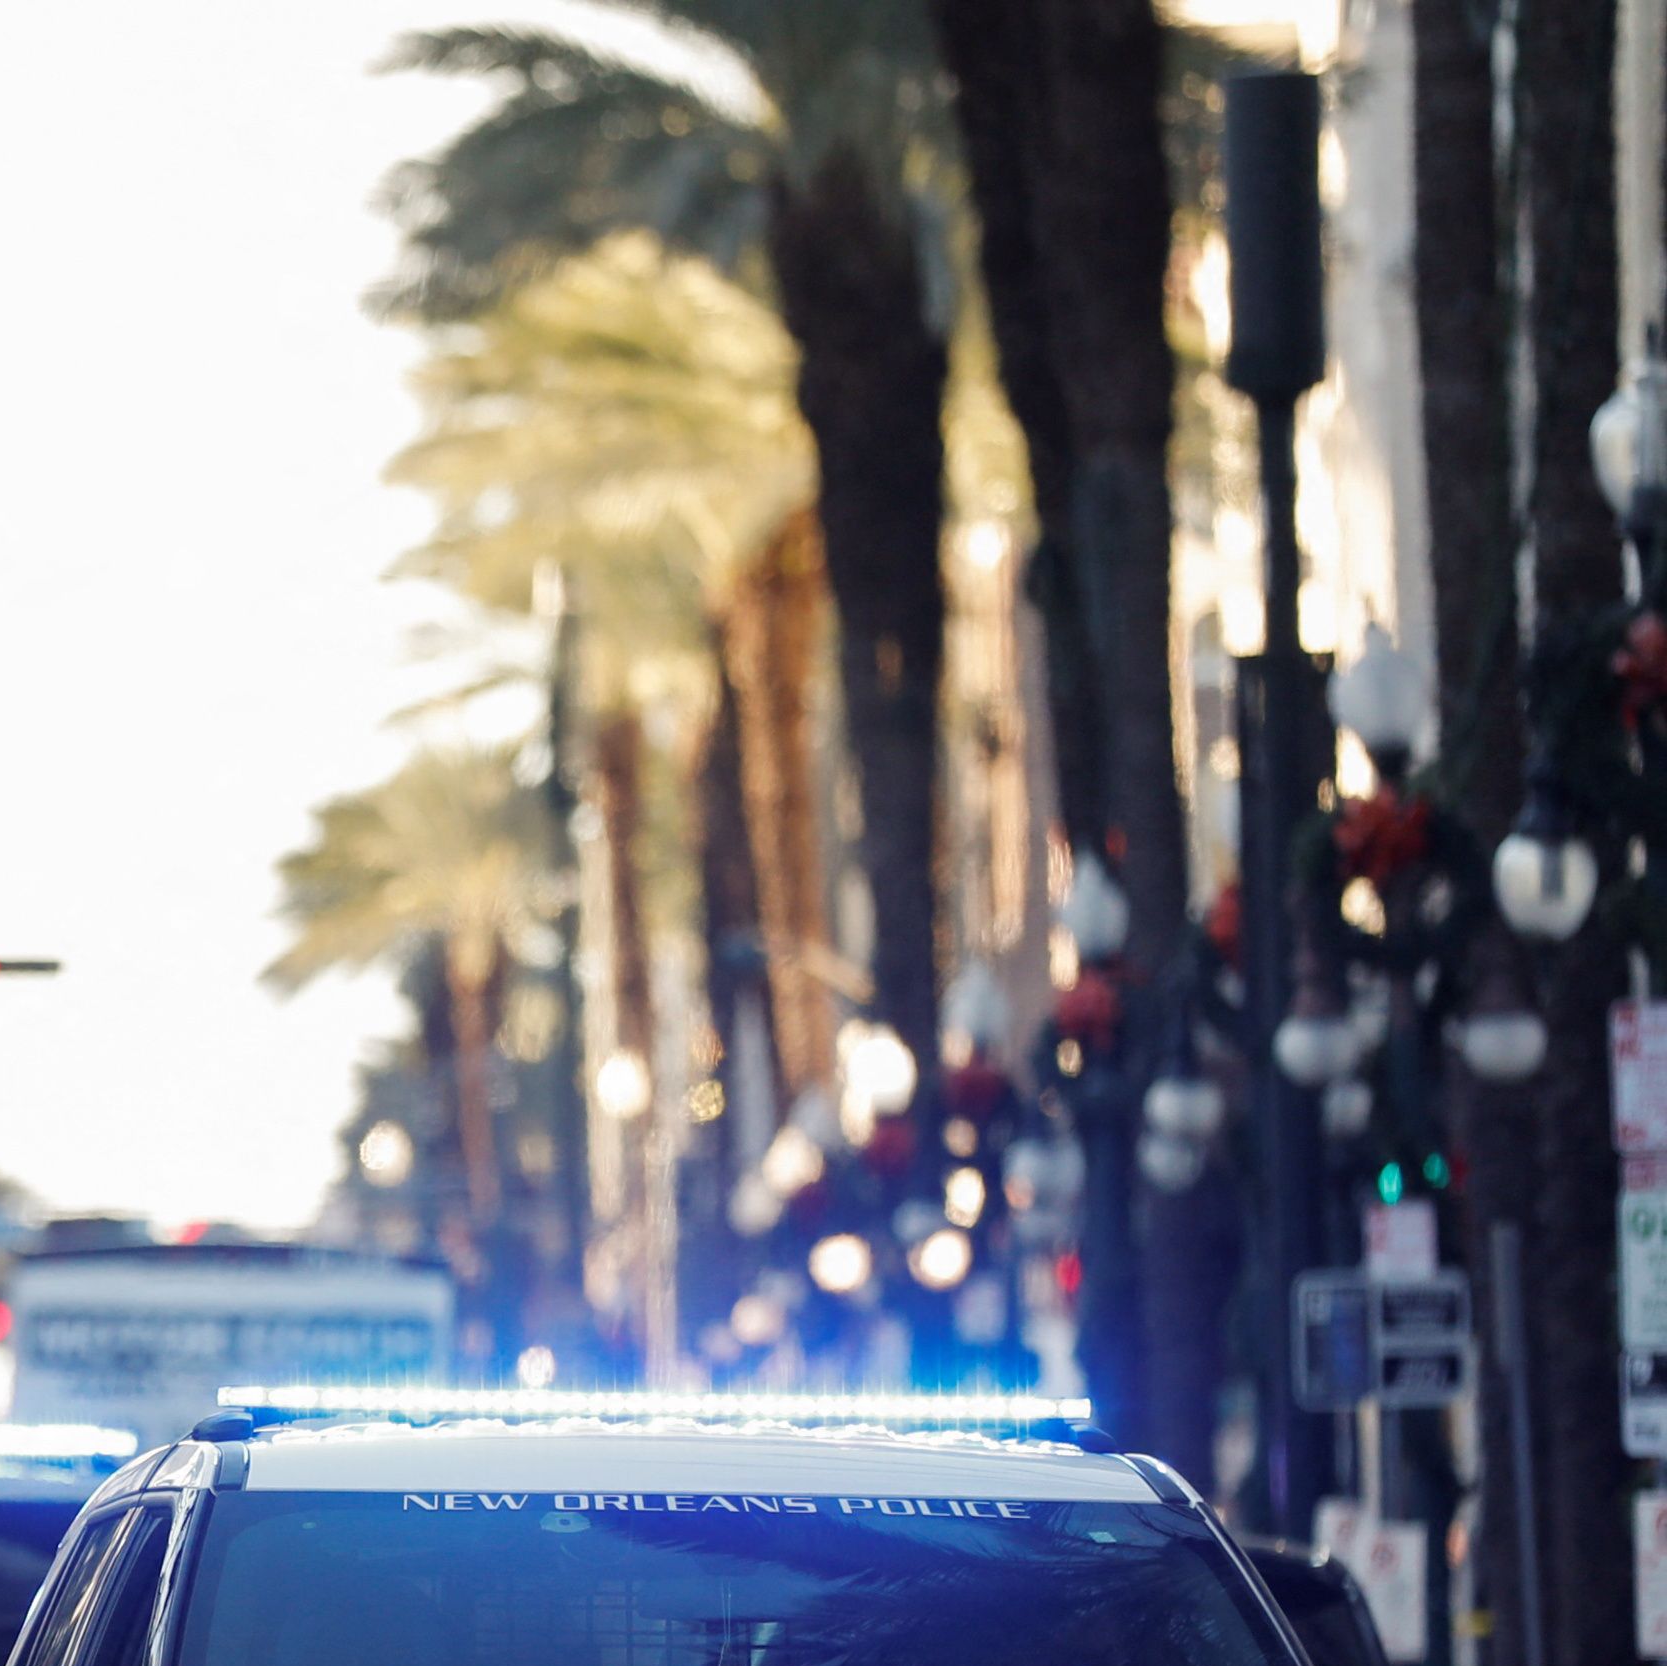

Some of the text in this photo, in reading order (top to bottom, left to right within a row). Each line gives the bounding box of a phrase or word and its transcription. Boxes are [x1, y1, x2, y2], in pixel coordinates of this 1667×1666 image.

[403, 1493, 1031, 1519] NEW ORLEANS POLICE
